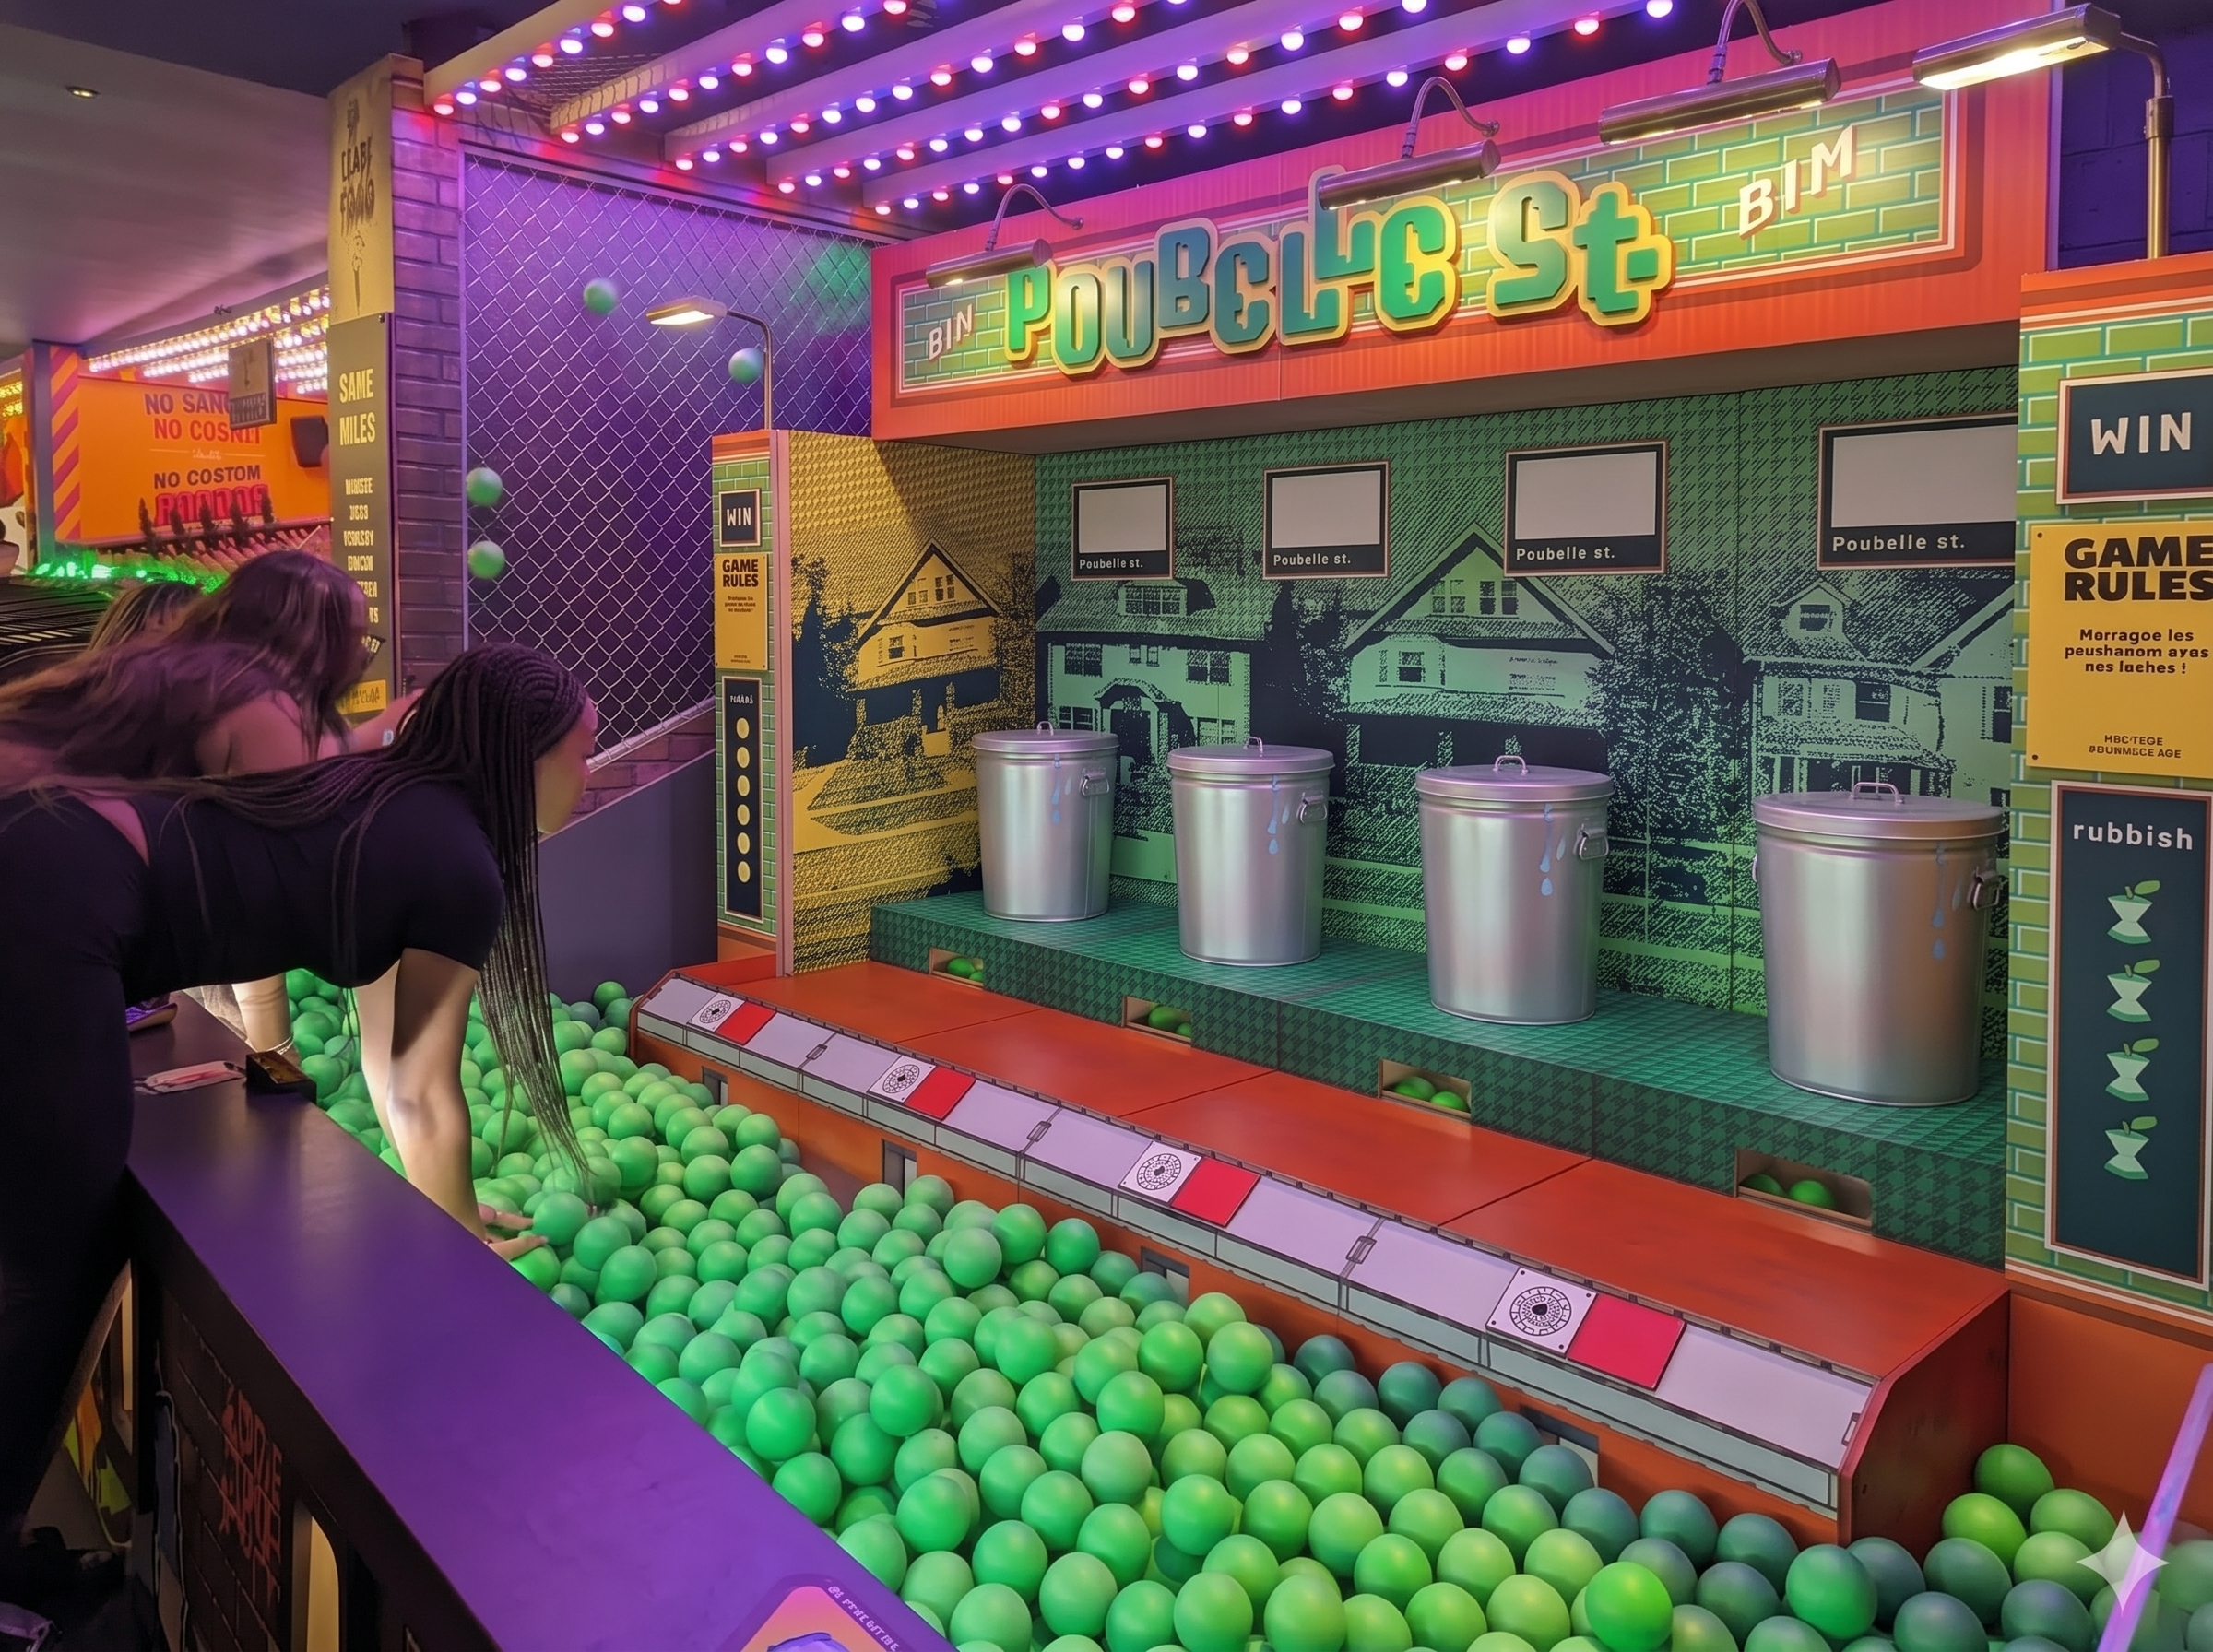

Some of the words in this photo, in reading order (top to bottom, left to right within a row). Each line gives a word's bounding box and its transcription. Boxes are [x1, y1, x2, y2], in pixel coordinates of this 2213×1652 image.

[1739, 124, 1855, 239] BIM
[1005, 166, 1459, 374] POUBELLE
[1488, 171, 1671, 326] St.
[929, 303, 973, 360] BIN
[339, 368, 374, 403] SAME
[144, 393, 174, 415] NO
[154, 418, 183, 440] NO
[339, 411, 376, 446] MILES
[2090, 411, 2192, 455] WIN
[154, 471, 181, 490] NO
[186, 465, 261, 487] COSTOM
[726, 507, 751, 527] WIN
[1516, 546, 1587, 561] Poubelle
[1593, 547, 1615, 559] st.
[1832, 533, 1928, 552] Poubelle
[1936, 534, 1965, 549] st.
[2064, 535, 2213, 570] GAME
[722, 558, 759, 573] GAME
[1079, 557, 1127, 570] Poubelle
[1129, 558, 1143, 568] st.
[1272, 553, 1329, 566] Poubelle
[1333, 553, 1352, 564] st.
[722, 573, 759, 588] RULES
[2064, 570, 2213, 602] RULES
[2168, 629, 2195, 642] les
[2085, 663, 2114, 673] nes
[2073, 821, 2194, 851] rubbish
